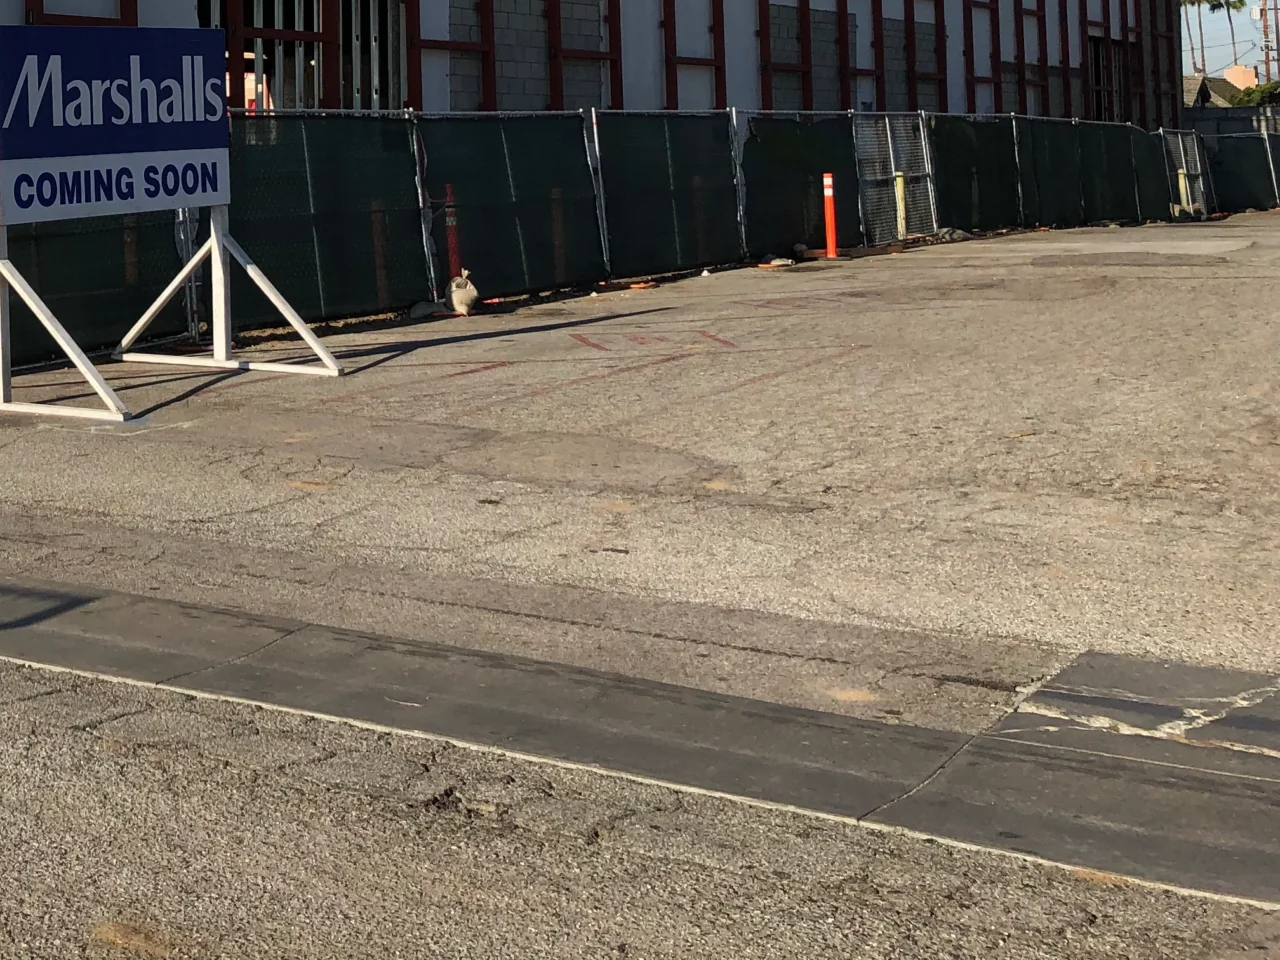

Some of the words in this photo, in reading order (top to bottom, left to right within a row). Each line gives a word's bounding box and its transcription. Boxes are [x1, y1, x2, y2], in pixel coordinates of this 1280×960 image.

[1, 54, 223, 129] Marshalls
[13, 167, 135, 209] COMING
[143, 162, 219, 199] SOON
